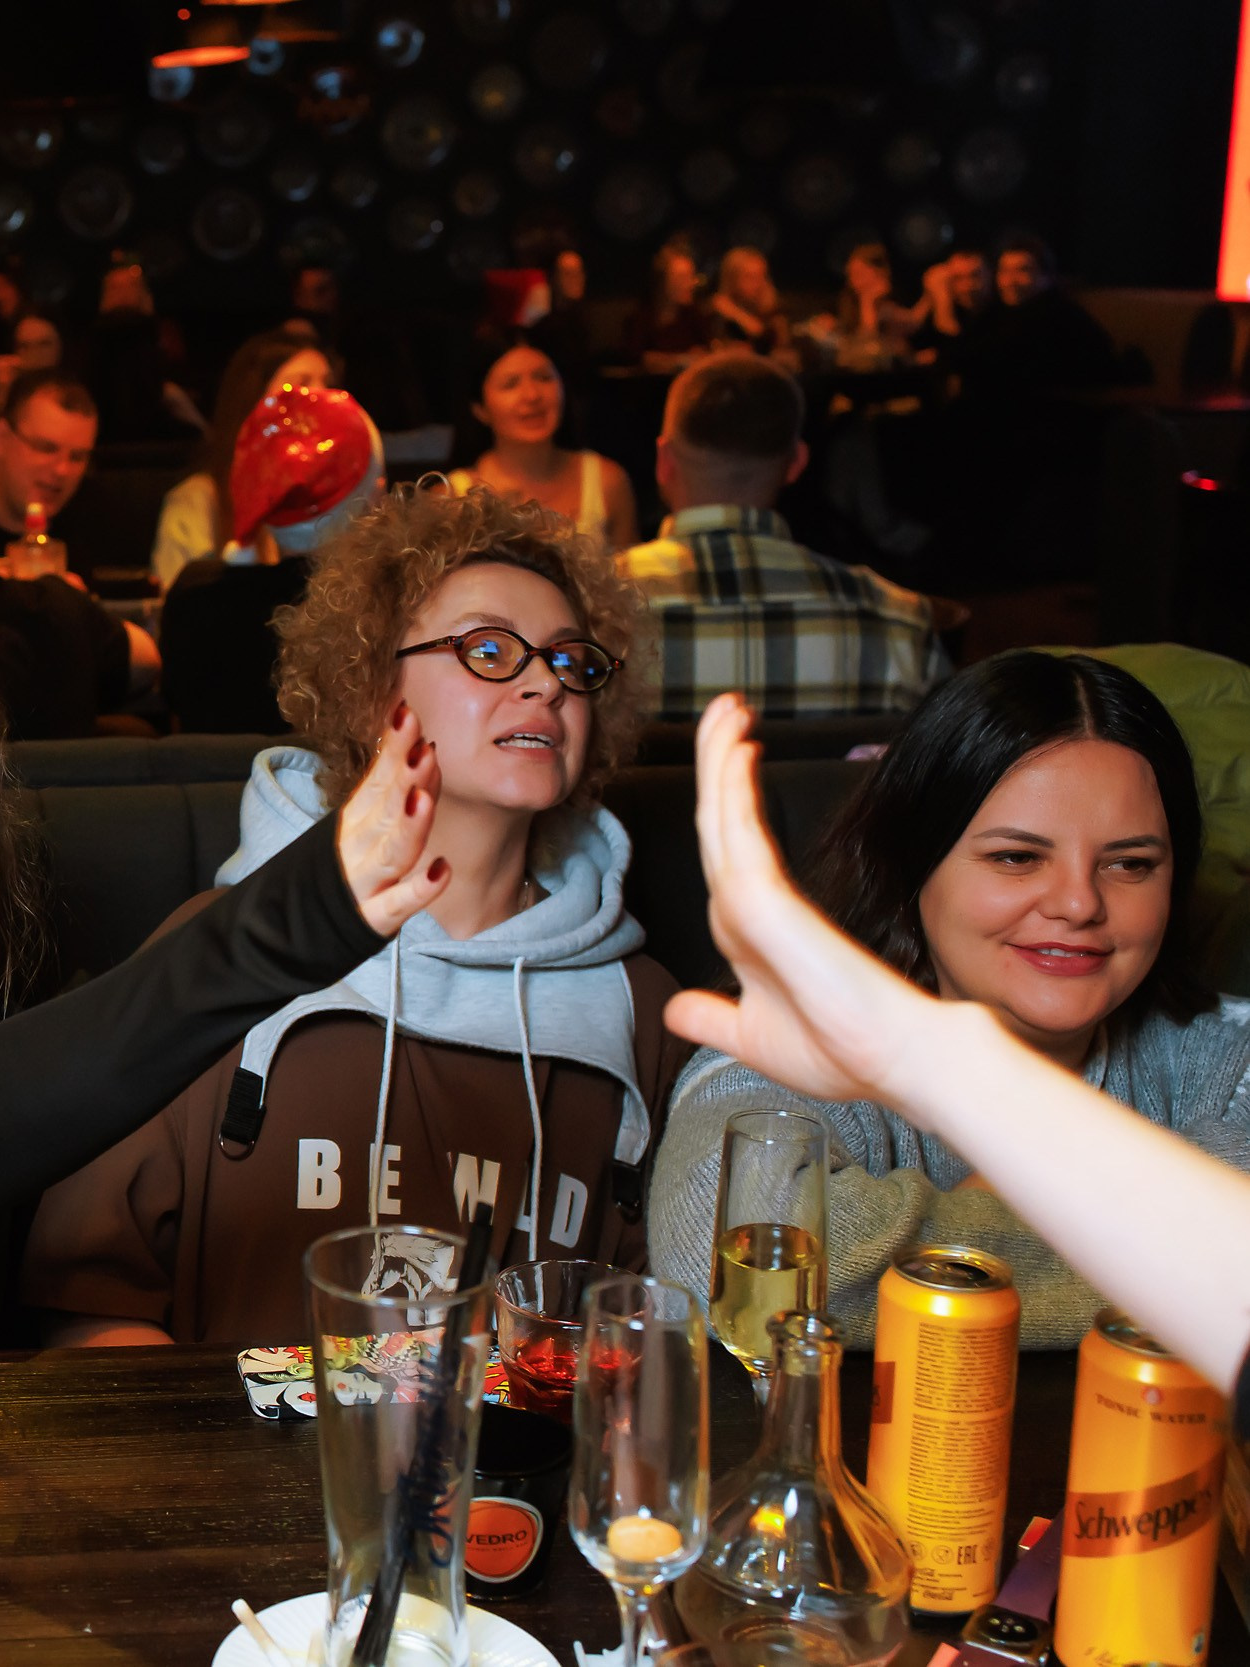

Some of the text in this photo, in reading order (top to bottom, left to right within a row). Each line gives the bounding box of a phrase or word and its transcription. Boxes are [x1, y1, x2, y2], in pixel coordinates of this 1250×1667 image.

[296, 1137, 402, 1216] BE
[1095, 1393, 1206, 1424] TONIC WATER
